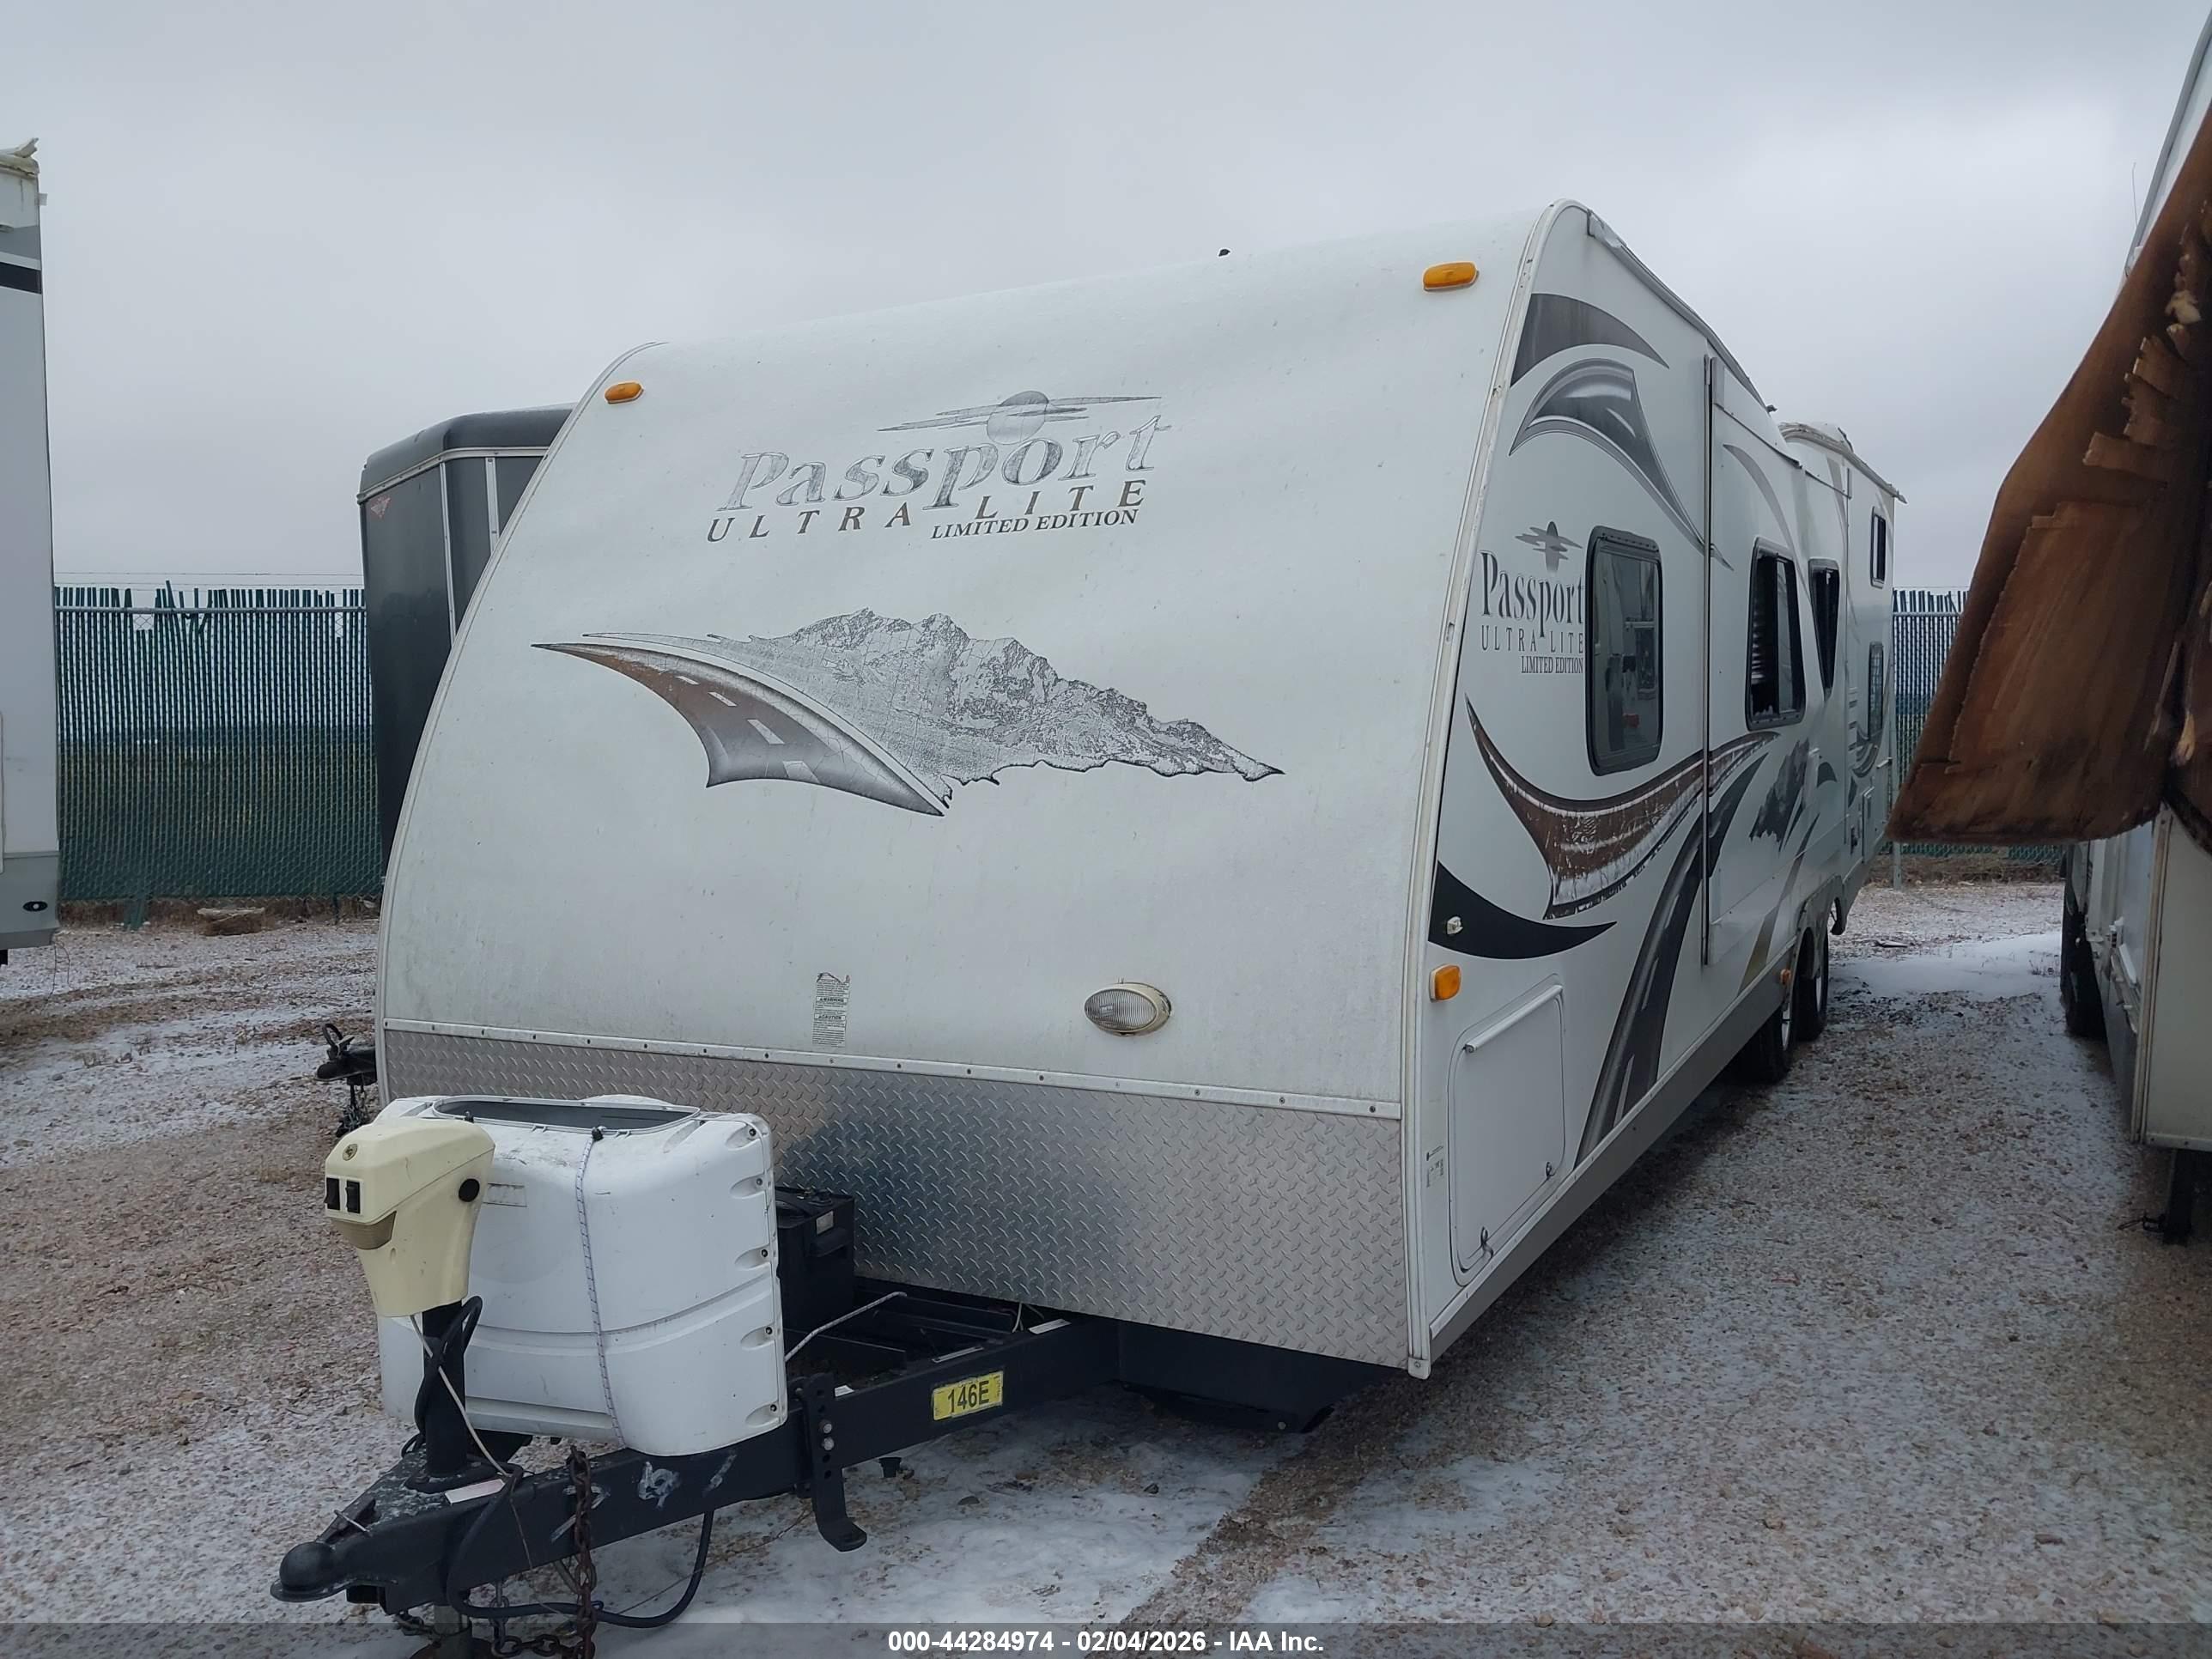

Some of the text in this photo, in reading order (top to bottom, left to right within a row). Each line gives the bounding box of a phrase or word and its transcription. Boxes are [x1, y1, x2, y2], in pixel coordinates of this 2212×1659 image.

[715, 415, 1172, 511] Passport
[707, 479, 1147, 543] ULTRA LITE
[931, 509, 1139, 539] LIMITED EDITION
[1480, 550, 1584, 638] Passport
[1481, 625, 1584, 653] ULTRA LITE
[1521, 655, 1584, 674] LIMITED EDITION
[947, 1380, 990, 1413] 146E
